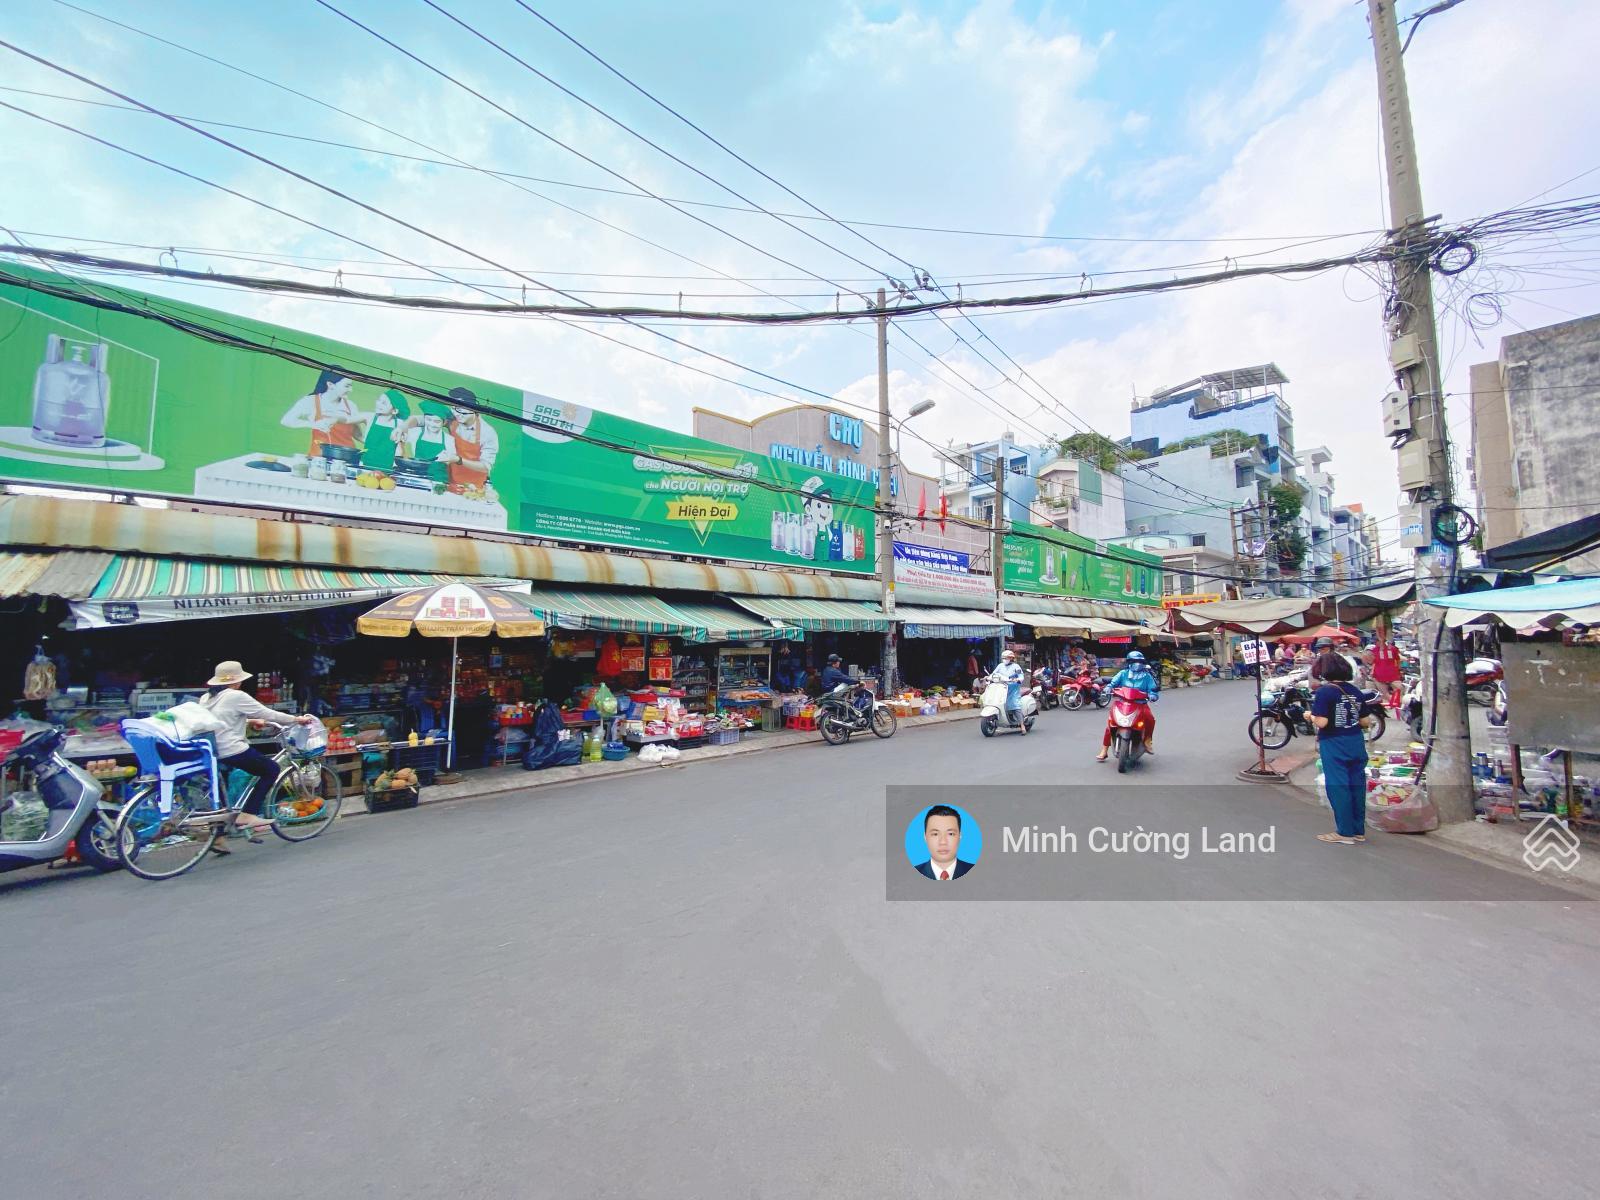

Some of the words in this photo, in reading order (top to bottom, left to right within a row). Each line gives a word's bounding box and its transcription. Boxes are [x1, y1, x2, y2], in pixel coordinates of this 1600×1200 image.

[534, 404, 561, 417] GAS
[532, 413, 574, 431] SOUTH
[829, 412, 864, 454] CHỢ
[770, 443, 833, 473] NGUYỄN
[837, 456, 867, 481] ĐÌNH
[660, 479, 700, 491] NGƯỜI
[703, 480, 724, 498] NỘI
[726, 482, 750, 498] TRỢ
[678, 505, 706, 519] Hiện
[710, 506, 731, 519] Đại
